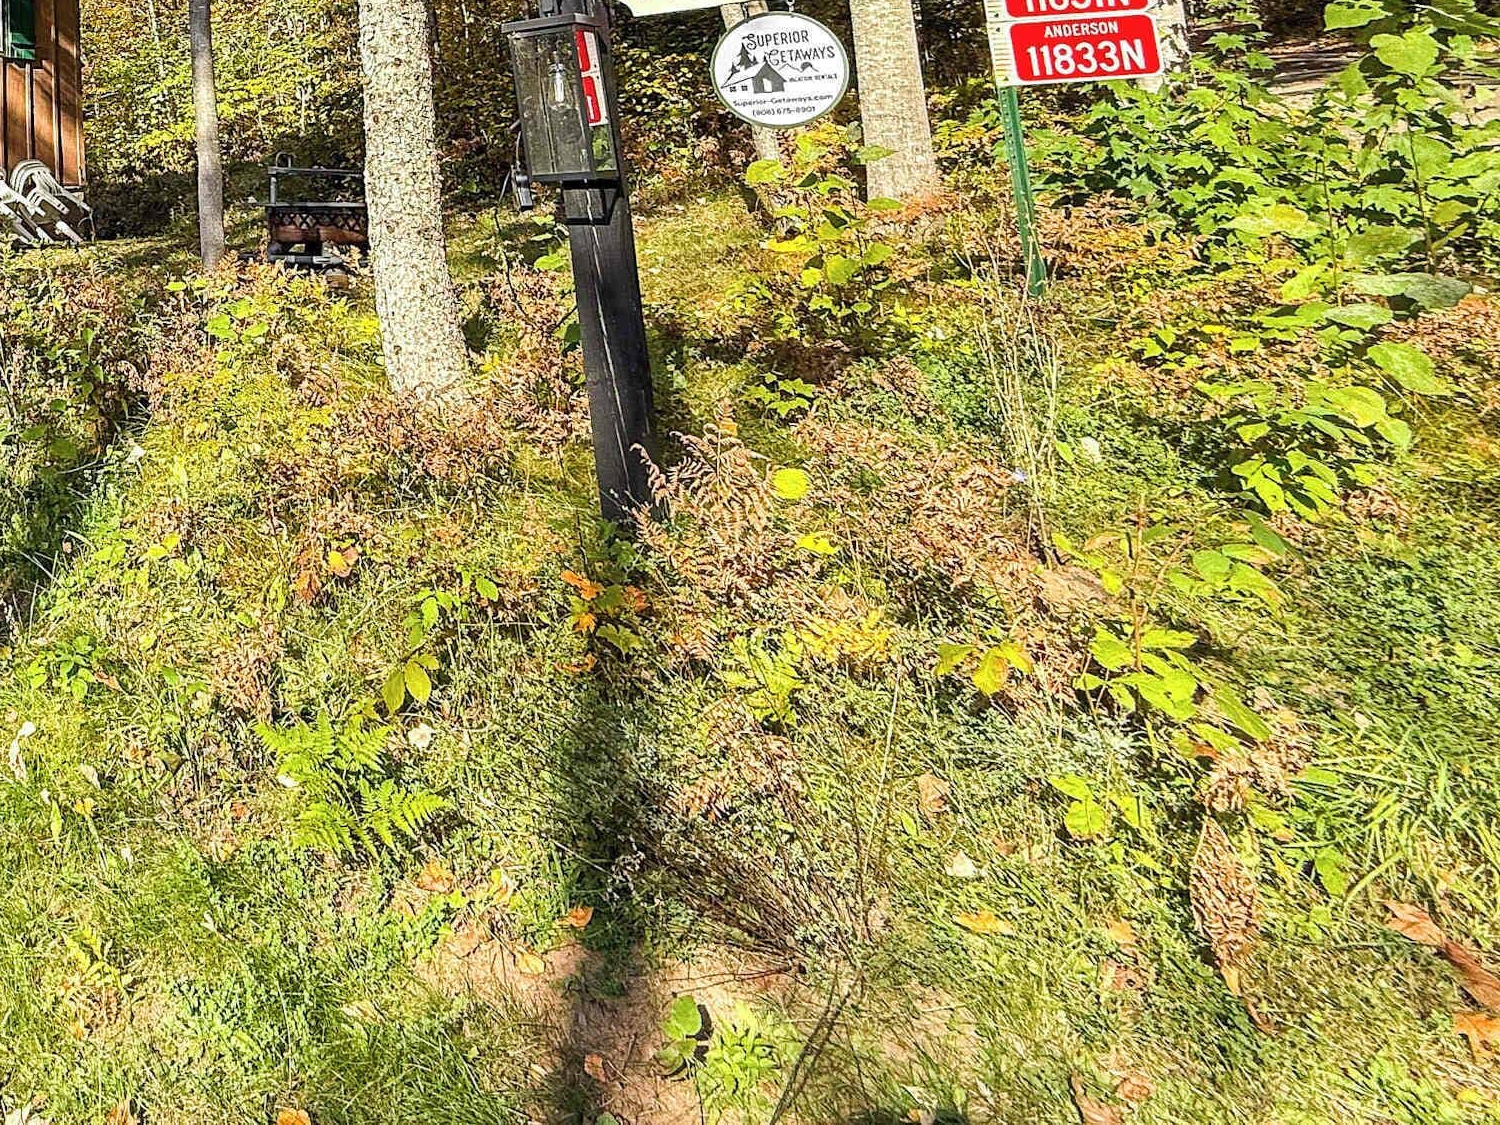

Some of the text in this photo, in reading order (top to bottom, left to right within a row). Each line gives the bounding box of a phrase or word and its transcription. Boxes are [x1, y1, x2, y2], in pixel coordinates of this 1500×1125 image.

[742, 29, 809, 50] SUPERIOR
[1044, 21, 1118, 38] ANDERSON
[764, 45, 836, 66] GETAWAYS
[1027, 38, 1147, 77] 11833N
